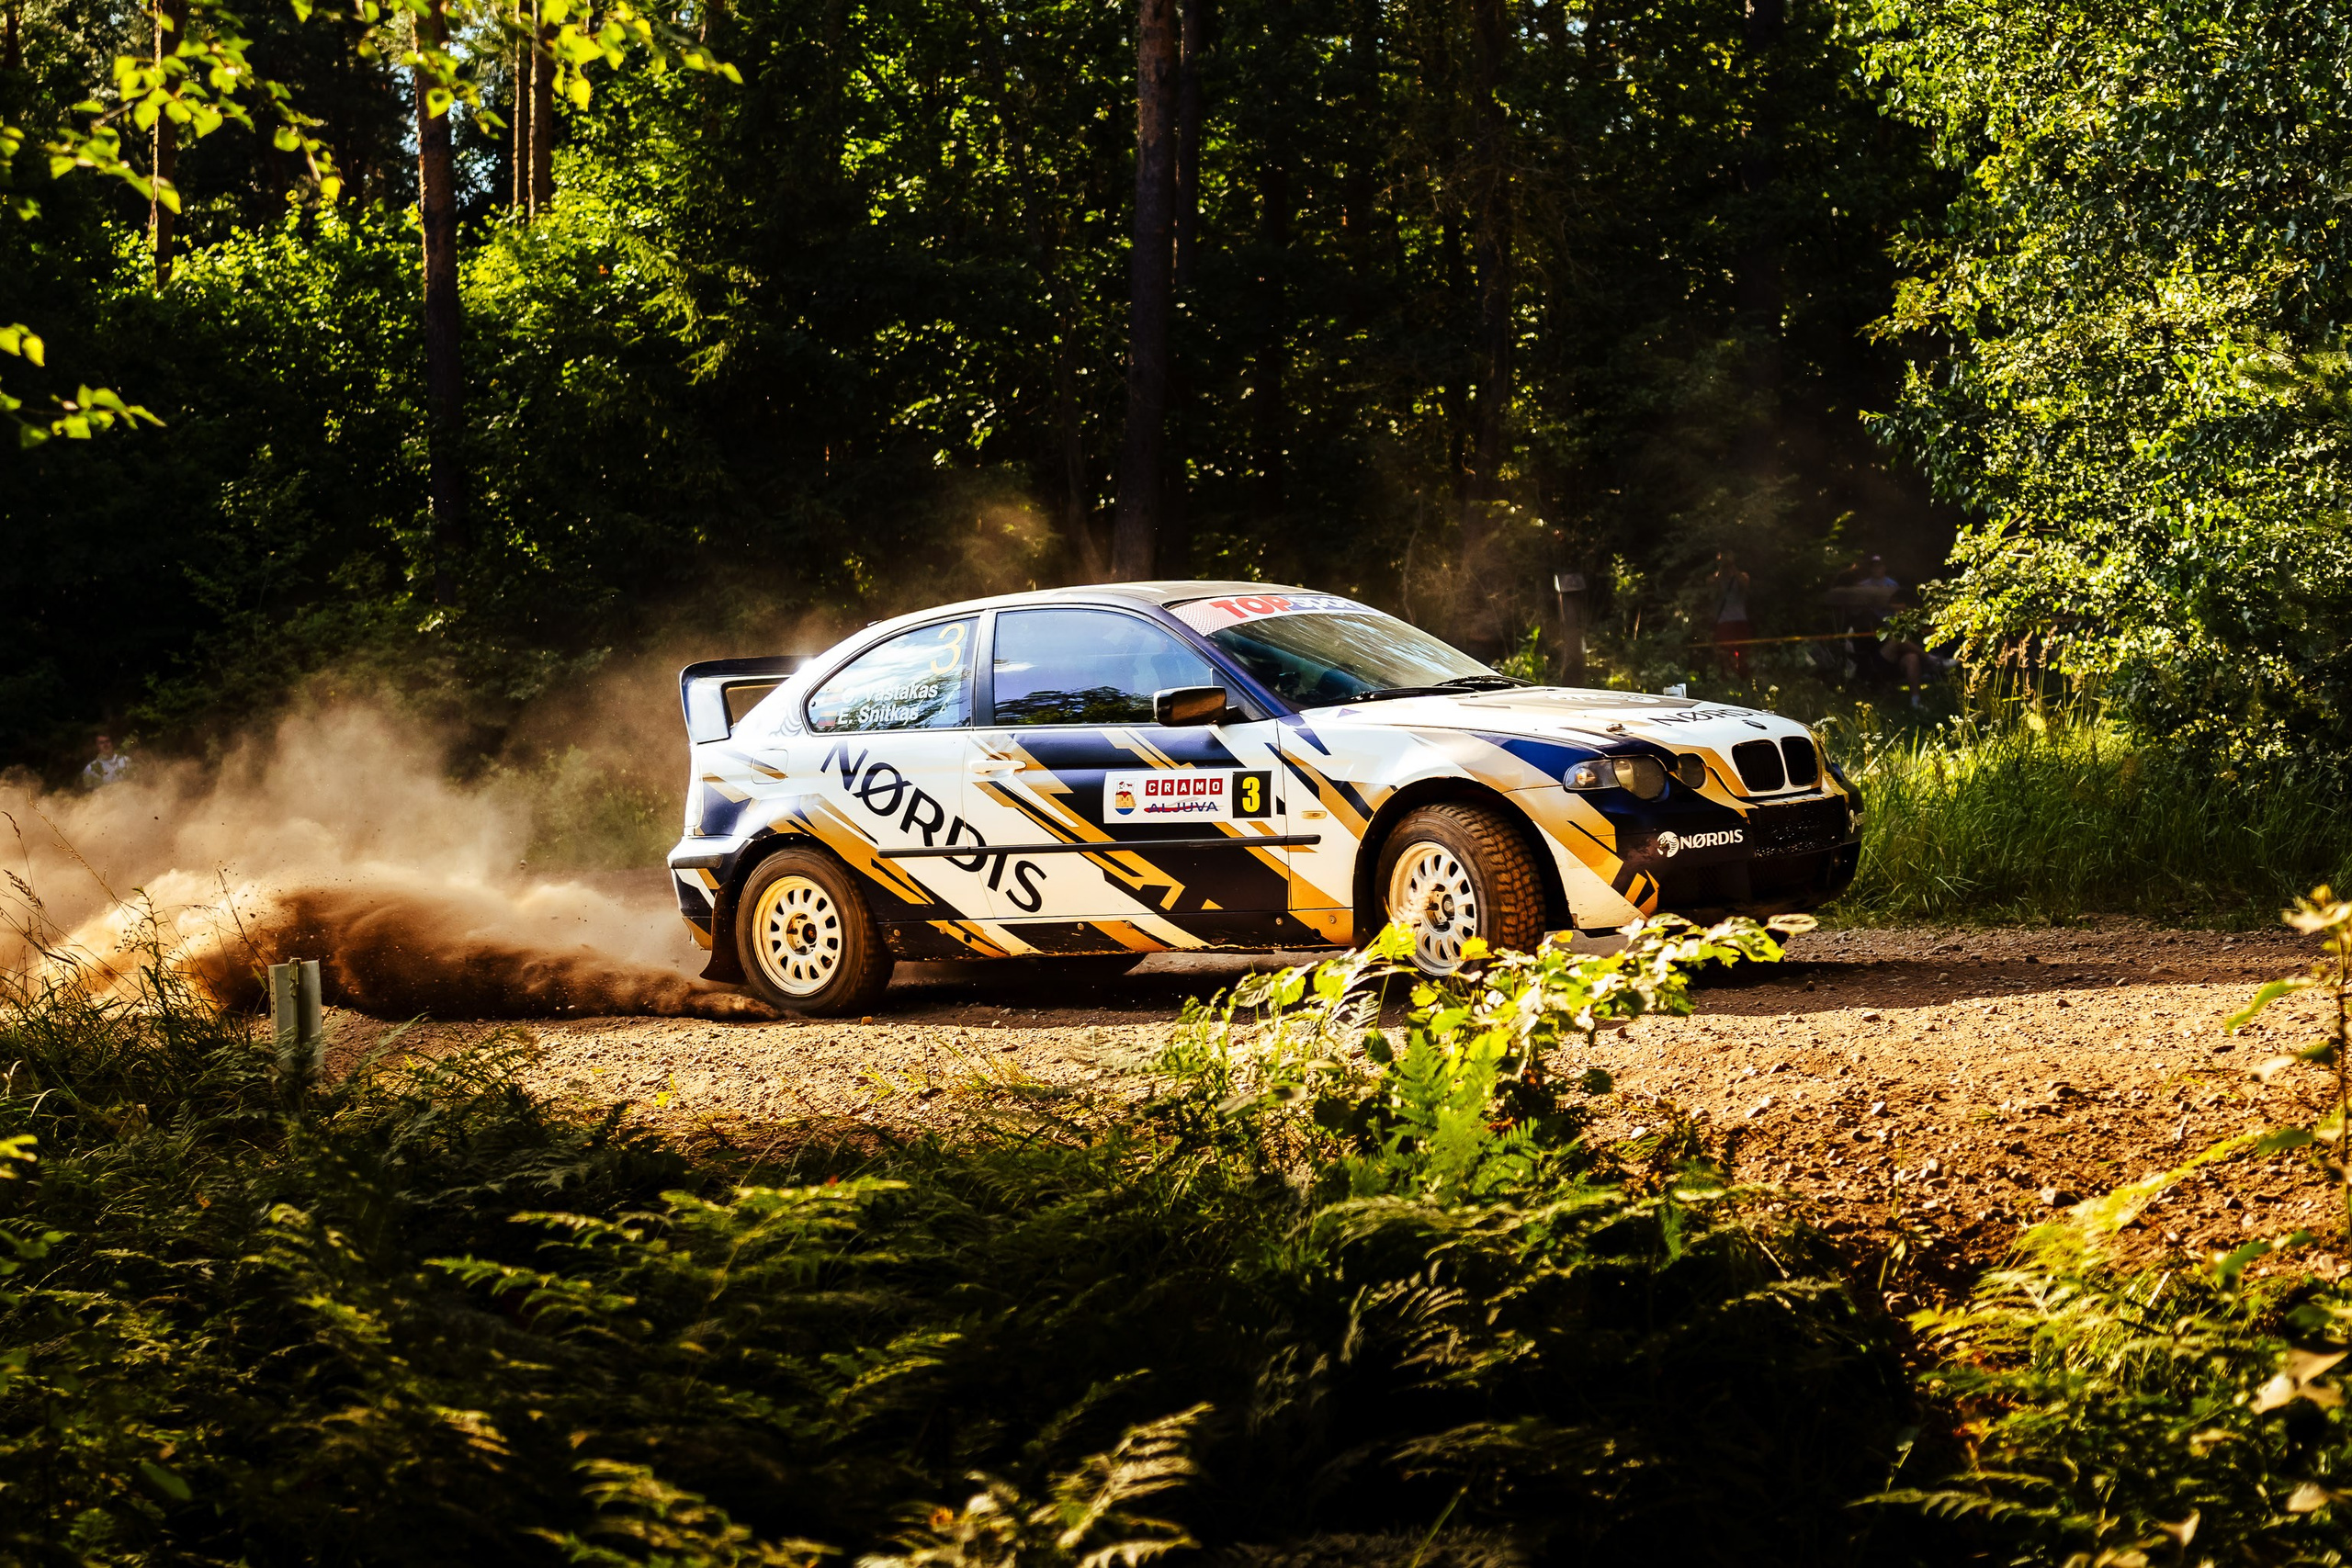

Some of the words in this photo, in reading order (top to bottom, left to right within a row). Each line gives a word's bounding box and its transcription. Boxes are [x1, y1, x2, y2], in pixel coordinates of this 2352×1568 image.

[930, 622, 966, 675] 3
[837, 706, 852, 725] E.
[1147, 780, 1221, 795] CRAMO
[1241, 776, 1261, 813] 3
[1149, 801, 1219, 813] ALJUVA
[820, 739, 1047, 913] NØRDIS
[1679, 829, 1744, 850] NØRDIS
